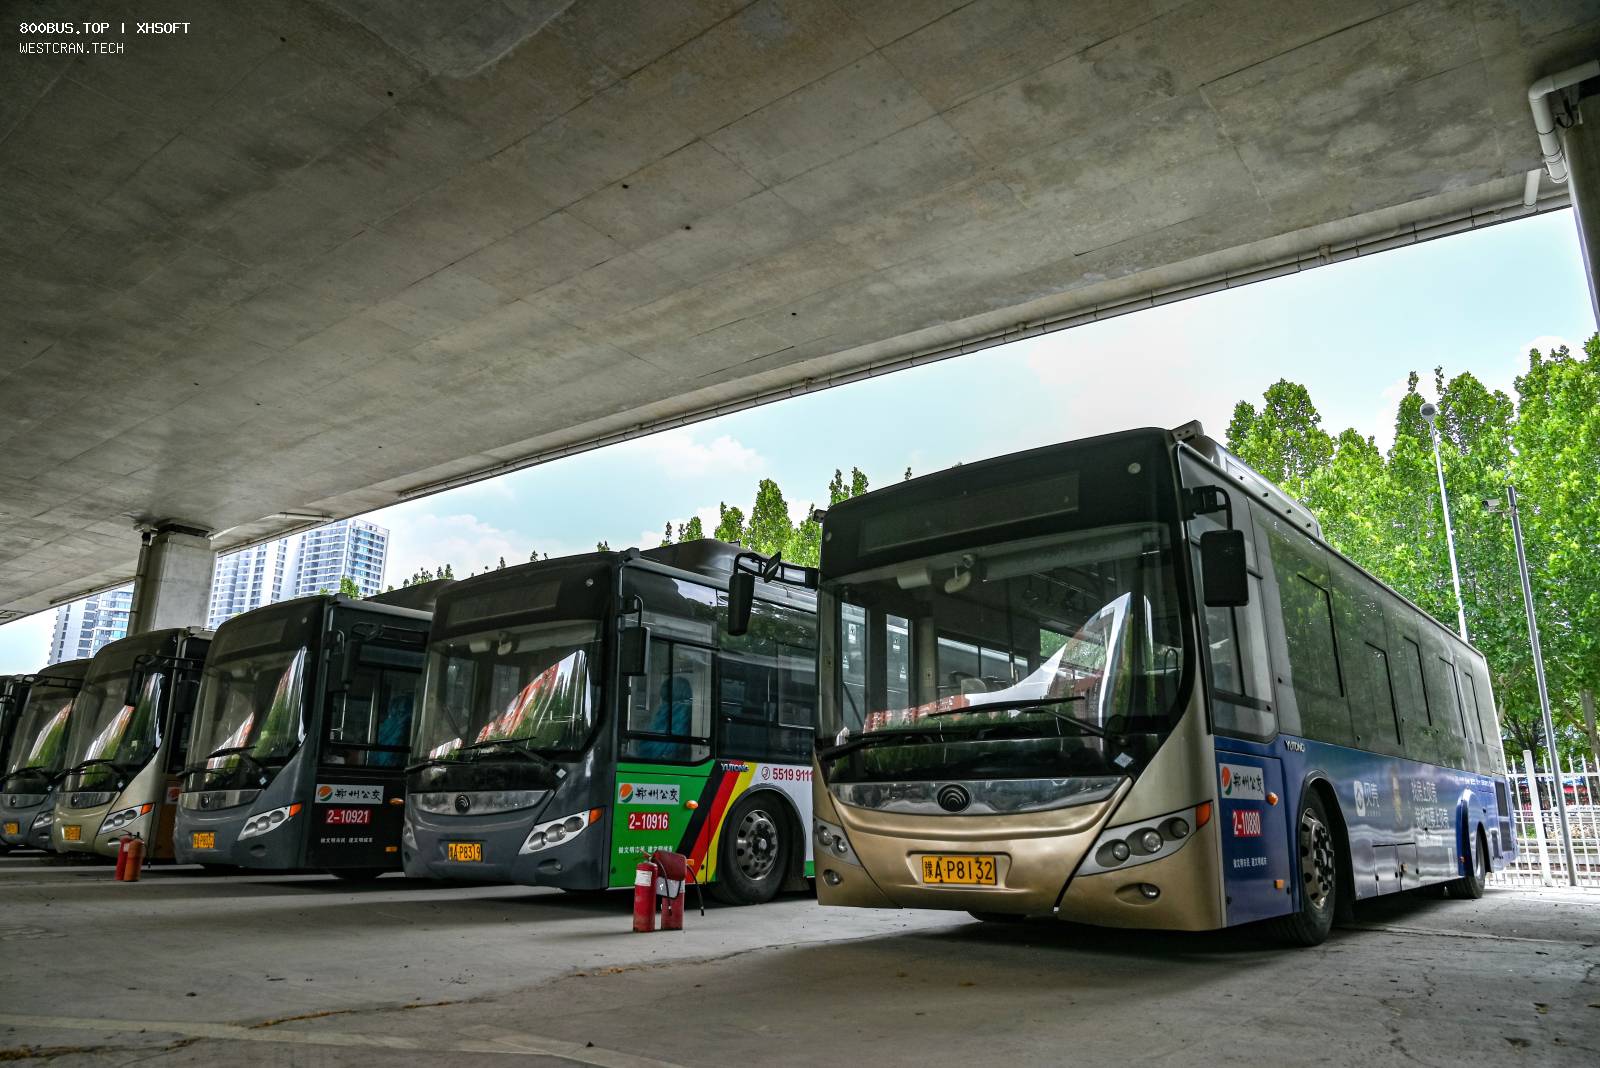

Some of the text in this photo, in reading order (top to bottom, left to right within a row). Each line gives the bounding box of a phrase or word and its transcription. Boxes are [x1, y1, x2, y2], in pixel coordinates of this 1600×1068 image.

[1285, 740, 1306, 753] YUTONG
[720, 762, 750, 772] YUTONG
[772, 767, 794, 780] 5519
[1232, 770, 1264, 794] 郑州公交
[335, 788, 382, 802] 郑州公交
[635, 787, 679, 802] 郑州公交
[327, 809, 369, 823] 2-10921
[629, 813, 668, 829] 2-10916
